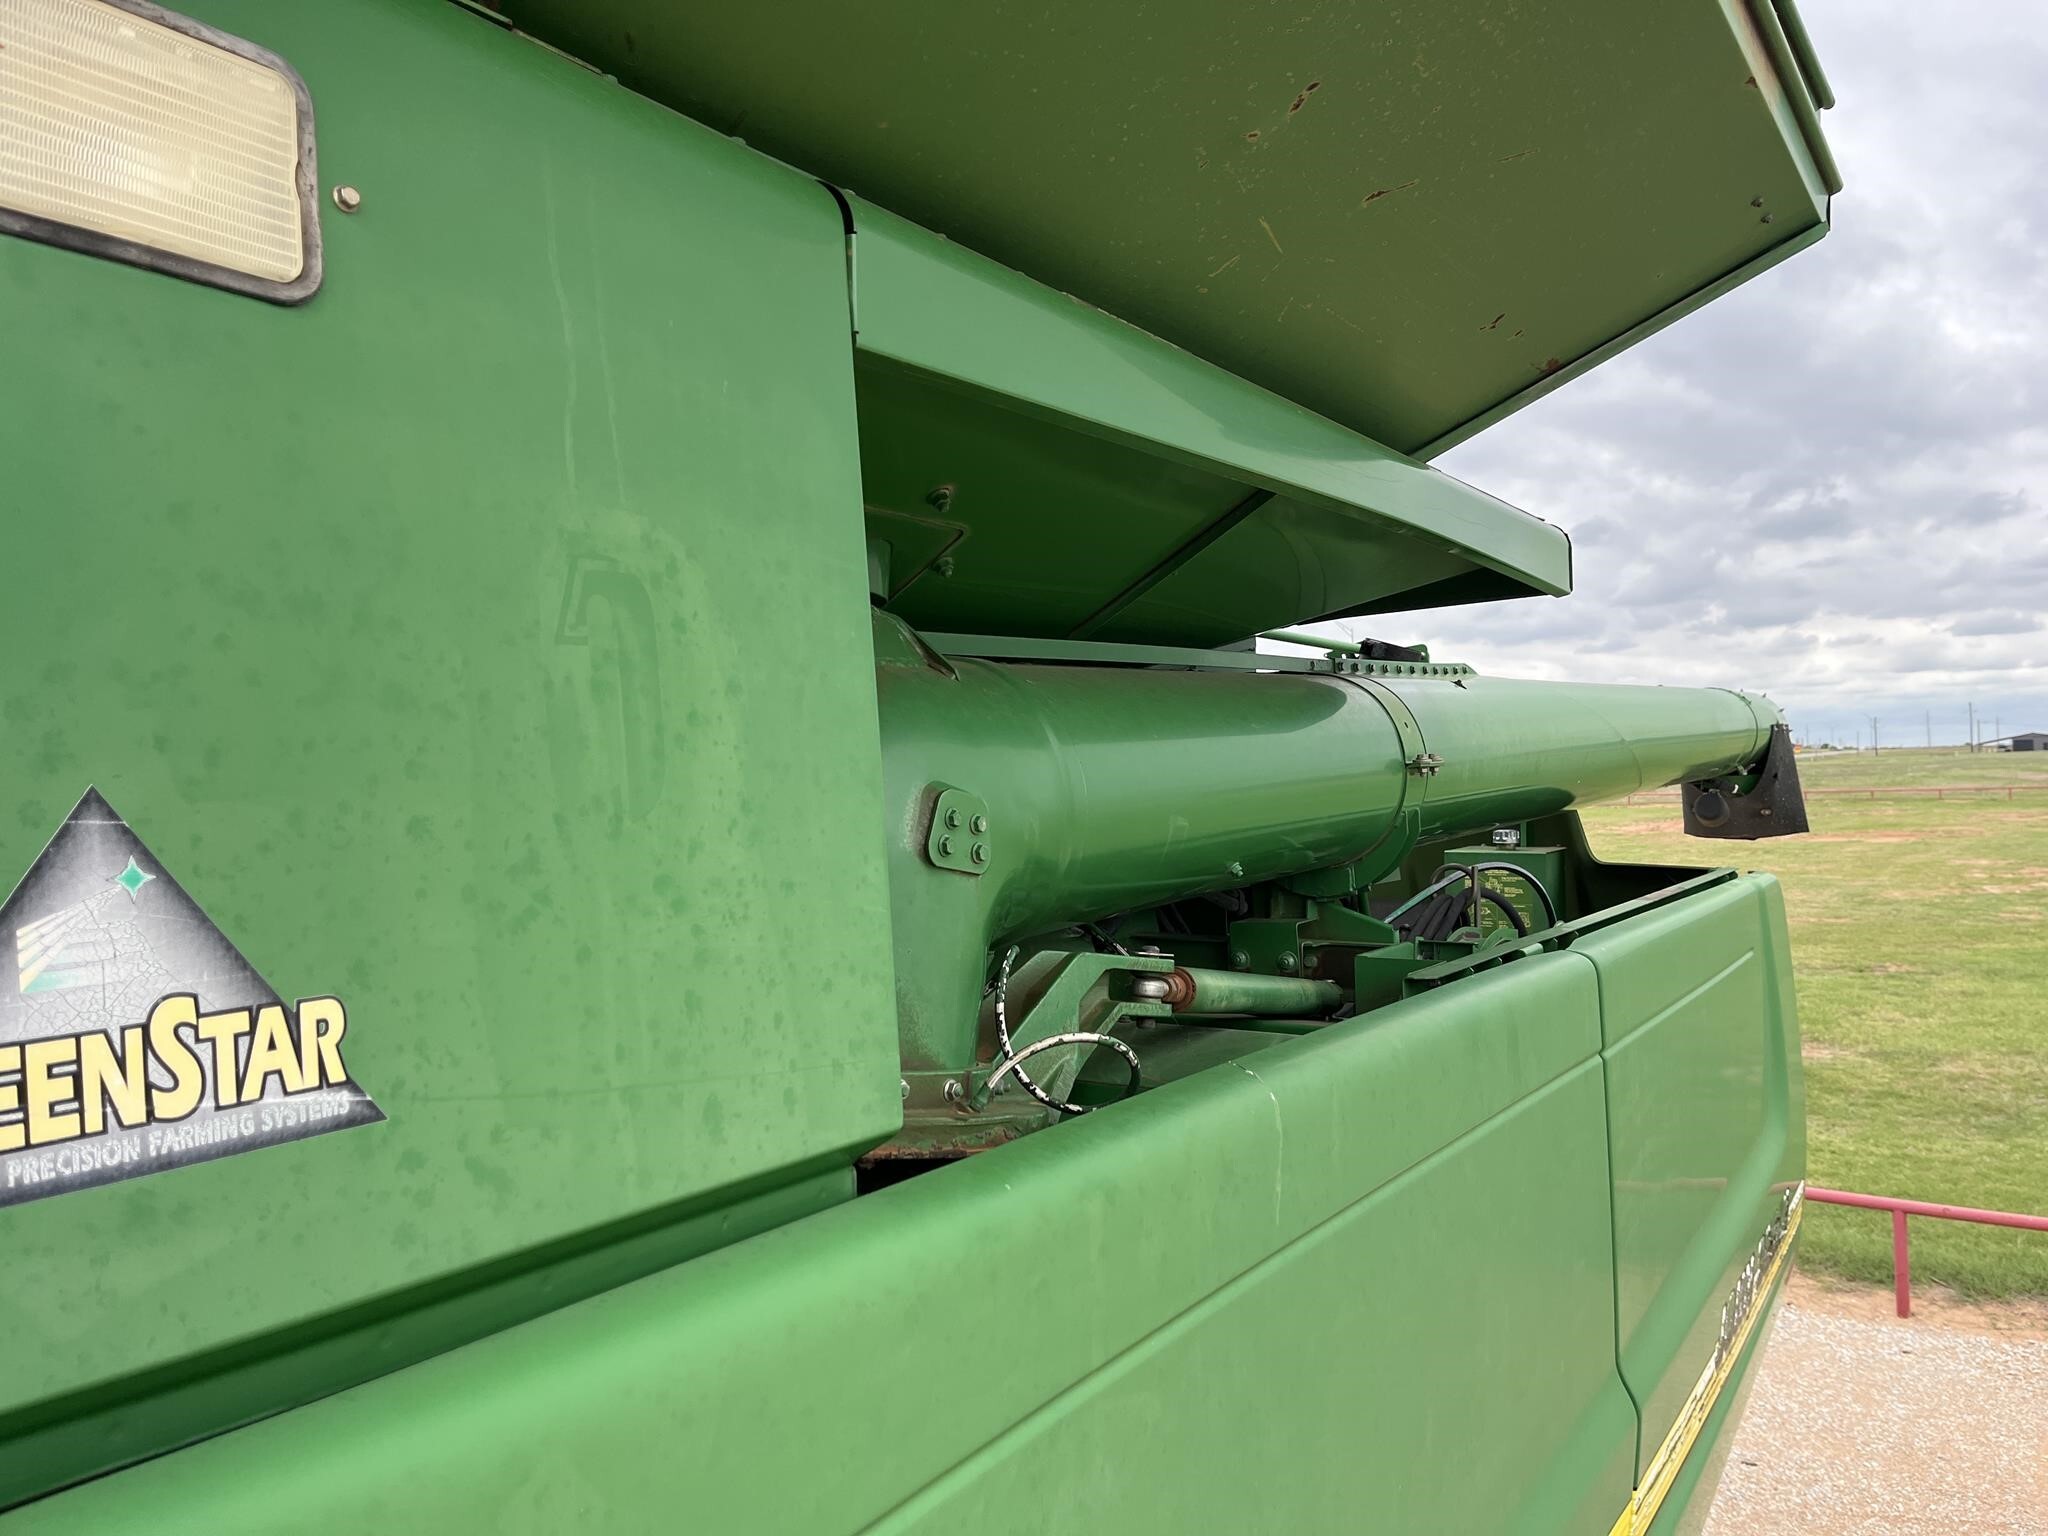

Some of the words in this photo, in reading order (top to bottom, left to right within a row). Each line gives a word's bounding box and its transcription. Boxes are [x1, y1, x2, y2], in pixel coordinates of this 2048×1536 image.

[7, 1138, 141, 1187] PRECISION
[149, 1114, 255, 1156] FARMING
[262, 1091, 350, 1132] SYSTEMS
